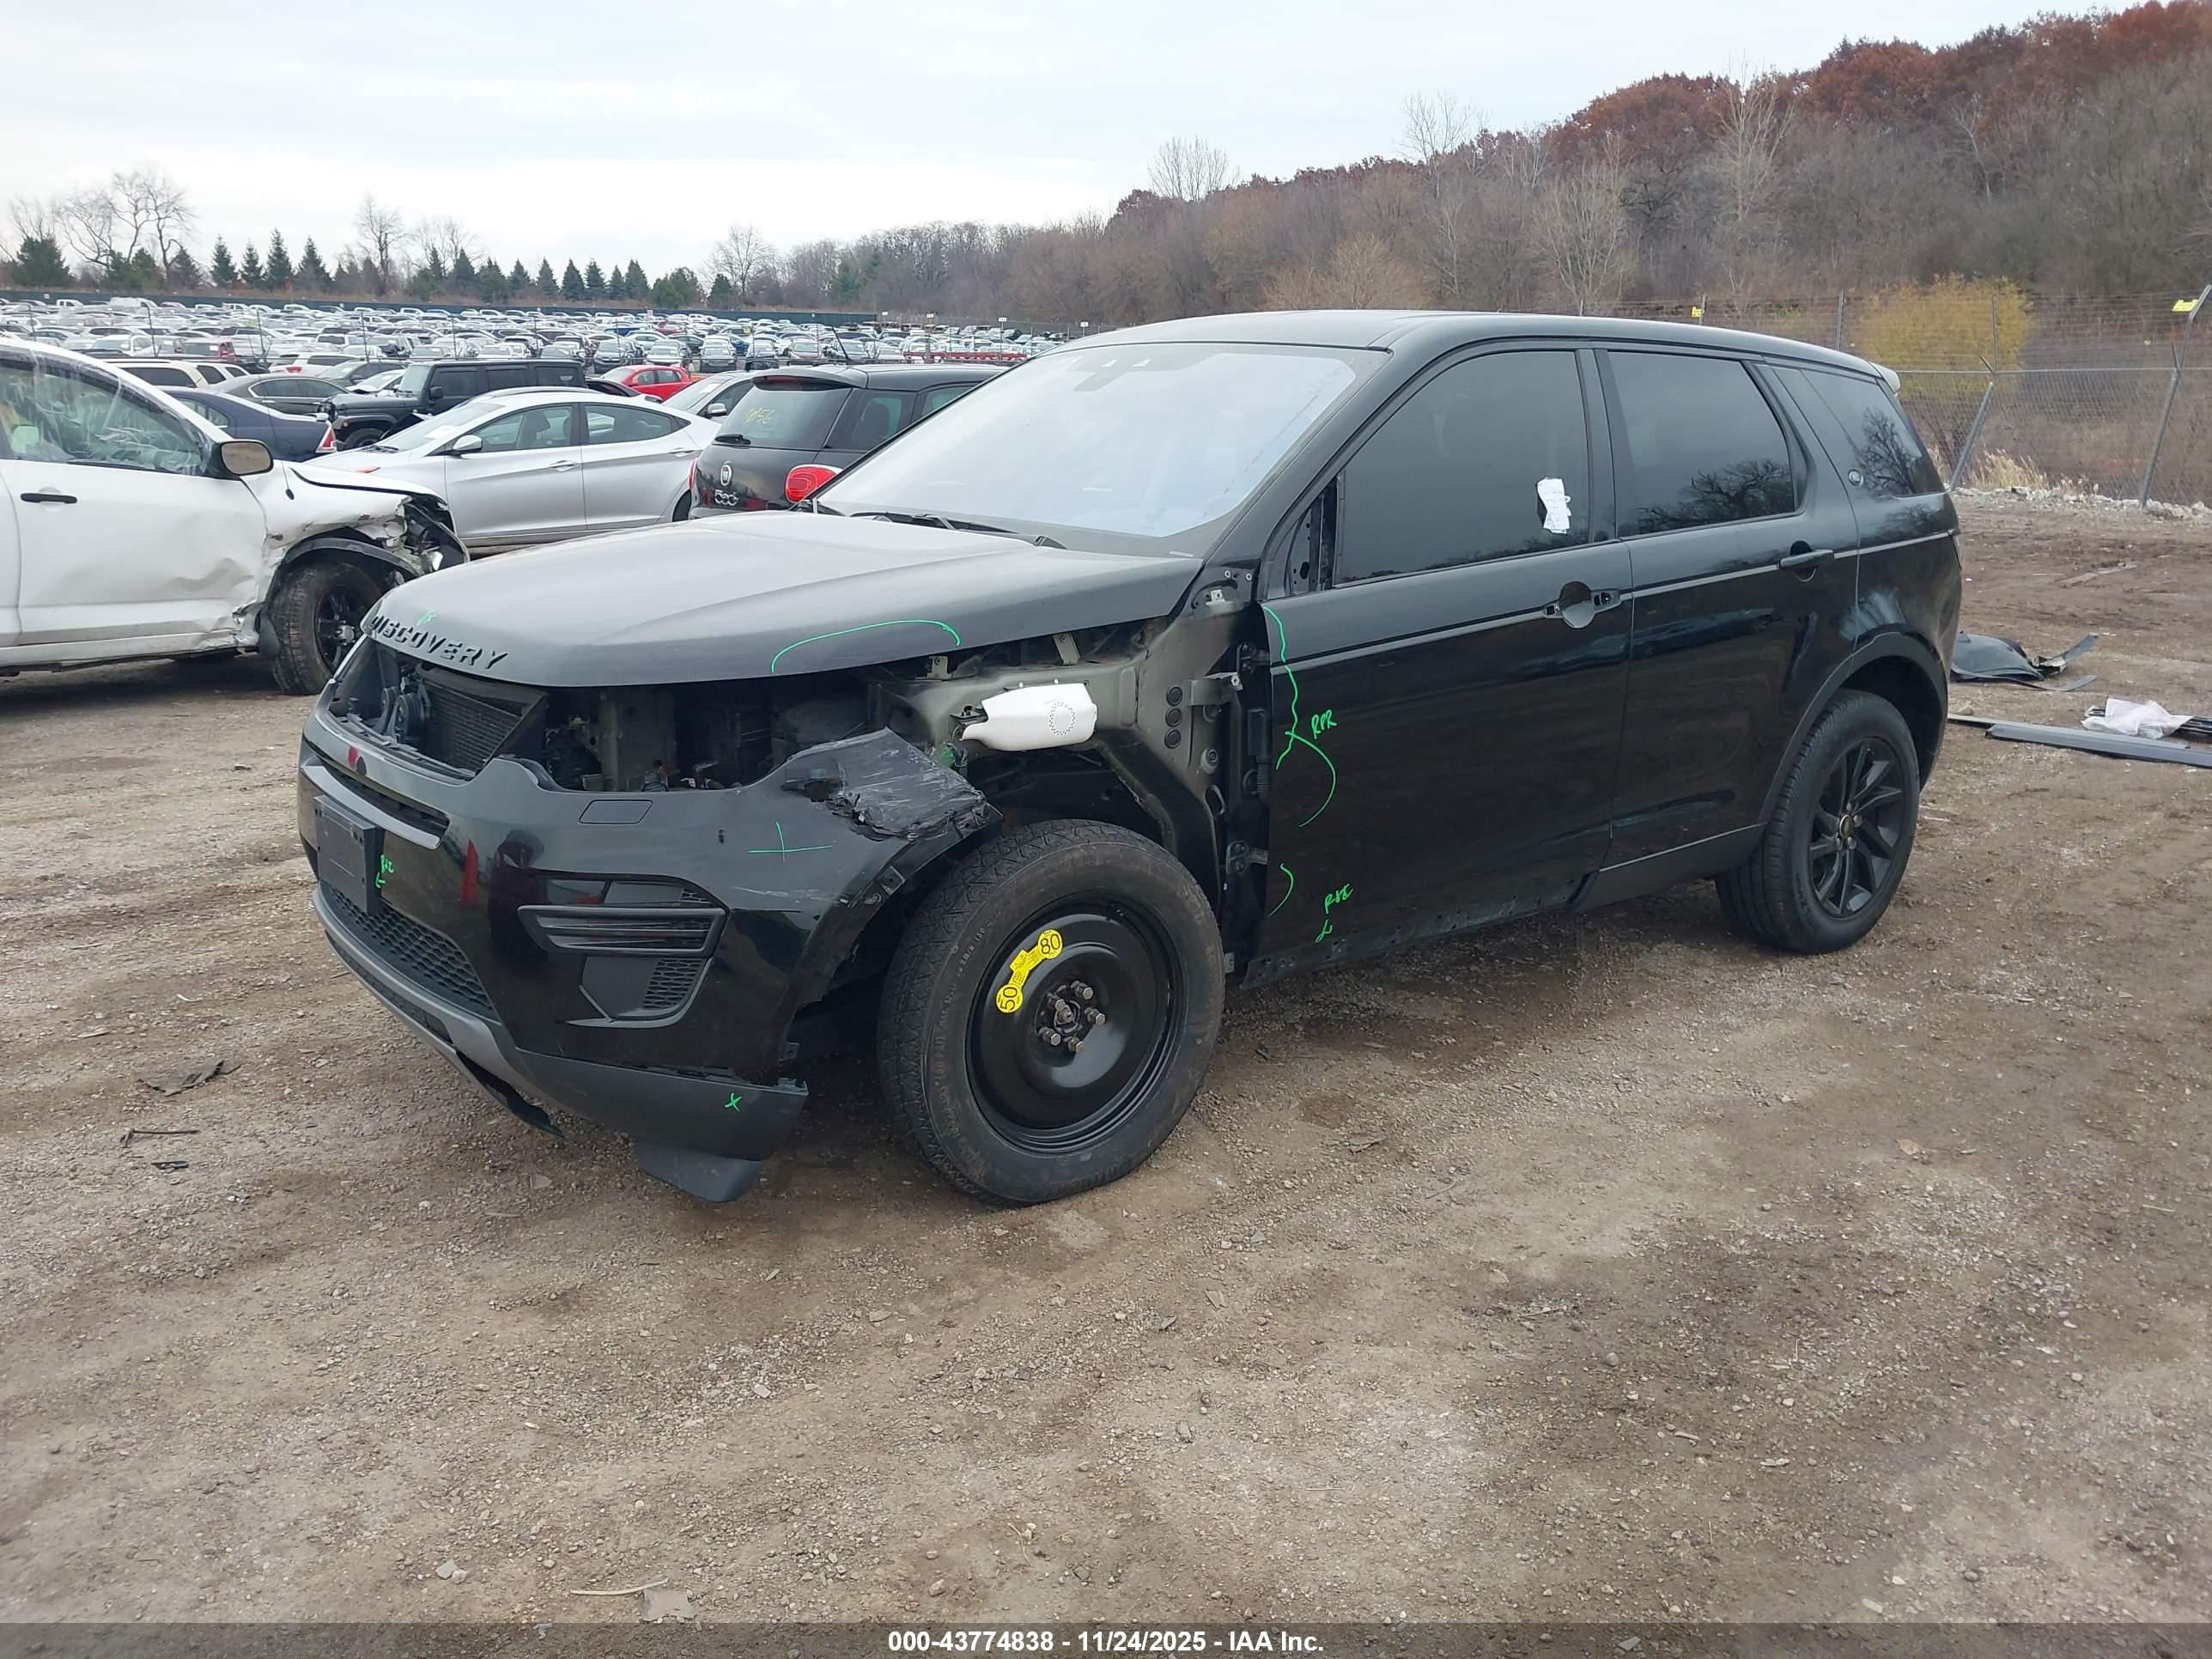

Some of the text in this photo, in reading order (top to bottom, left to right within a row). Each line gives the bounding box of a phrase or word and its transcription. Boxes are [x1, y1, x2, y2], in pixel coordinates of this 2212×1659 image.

[368, 615, 508, 670] DISCOVERY
[1040, 933, 1061, 955] 80
[1000, 986, 1018, 1011] 50
